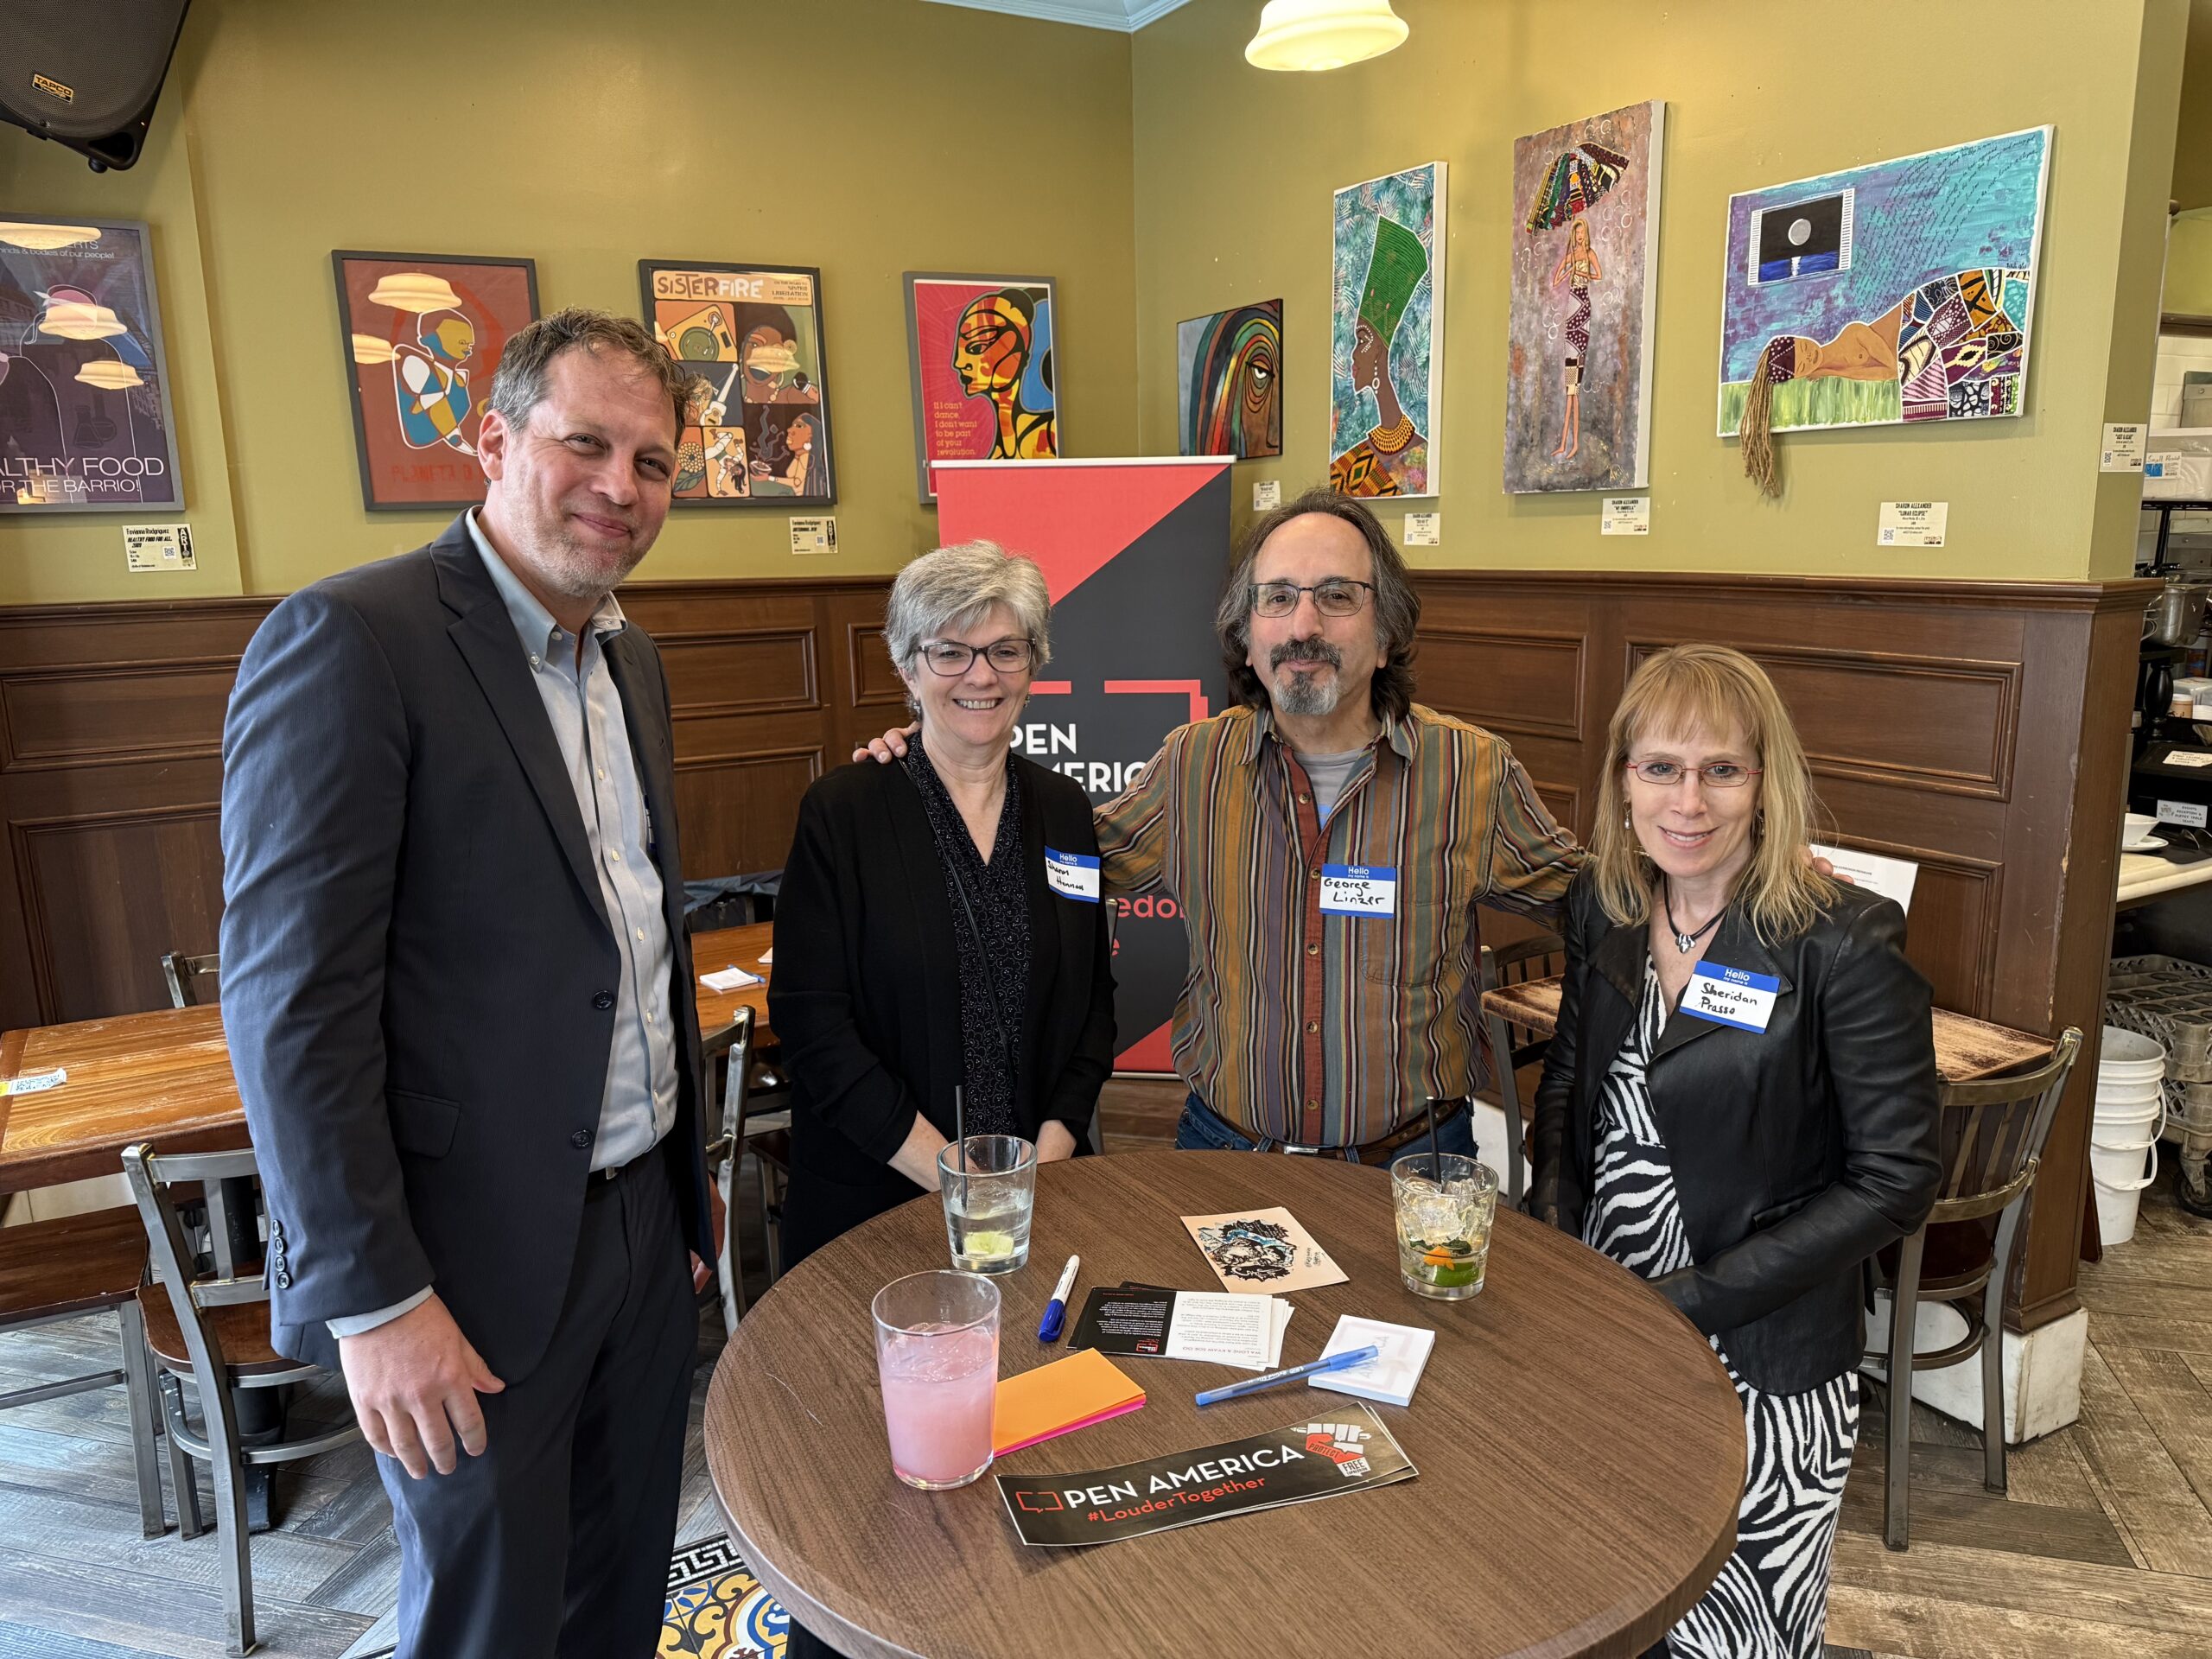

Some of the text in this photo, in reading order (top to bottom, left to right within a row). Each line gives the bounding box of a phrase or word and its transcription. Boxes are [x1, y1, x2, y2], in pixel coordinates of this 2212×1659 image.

[36, 76, 72, 96] TAPCO
[658, 274, 764, 298] SISTERFIRE
[955, 430, 971, 439] part
[82, 457, 164, 476] FOOD
[0, 480, 141, 493] R THE BARRIO!
[1009, 723, 1077, 754] PEN
[1059, 853, 1077, 862] Hello
[1348, 866, 1370, 875] Hello
[1324, 878, 1371, 897] George
[1725, 968, 1751, 982] Hello
[1700, 982, 1758, 1006] Sheridan
[1308, 1443, 1339, 1459] PROTECT
[1341, 1459, 1365, 1472] FREE
[1063, 1444, 1305, 1509] PEN AMERICA
[1087, 1478, 1266, 1522] #LouderTogether
